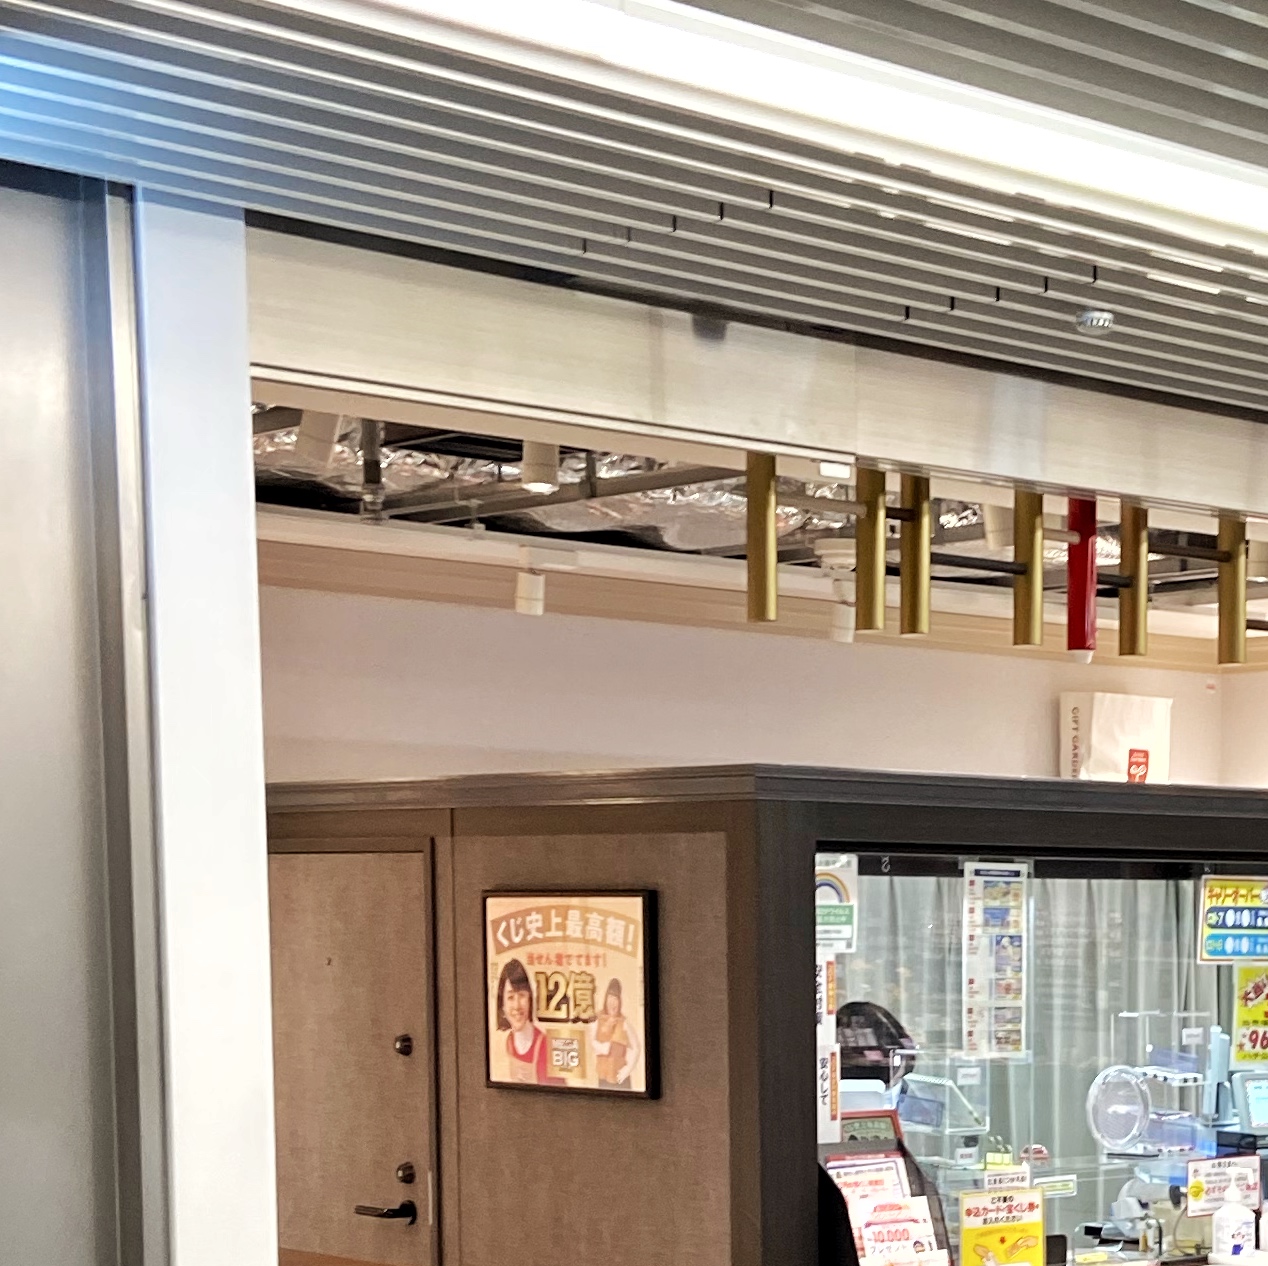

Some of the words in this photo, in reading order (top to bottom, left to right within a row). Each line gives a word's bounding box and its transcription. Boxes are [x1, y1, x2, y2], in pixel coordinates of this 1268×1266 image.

[1071, 706, 1081, 732] GIFT
[496, 908, 635, 952] くじ史上最高額!
[534, 970, 598, 1024] 12億
[552, 1051, 579, 1068] BIG
